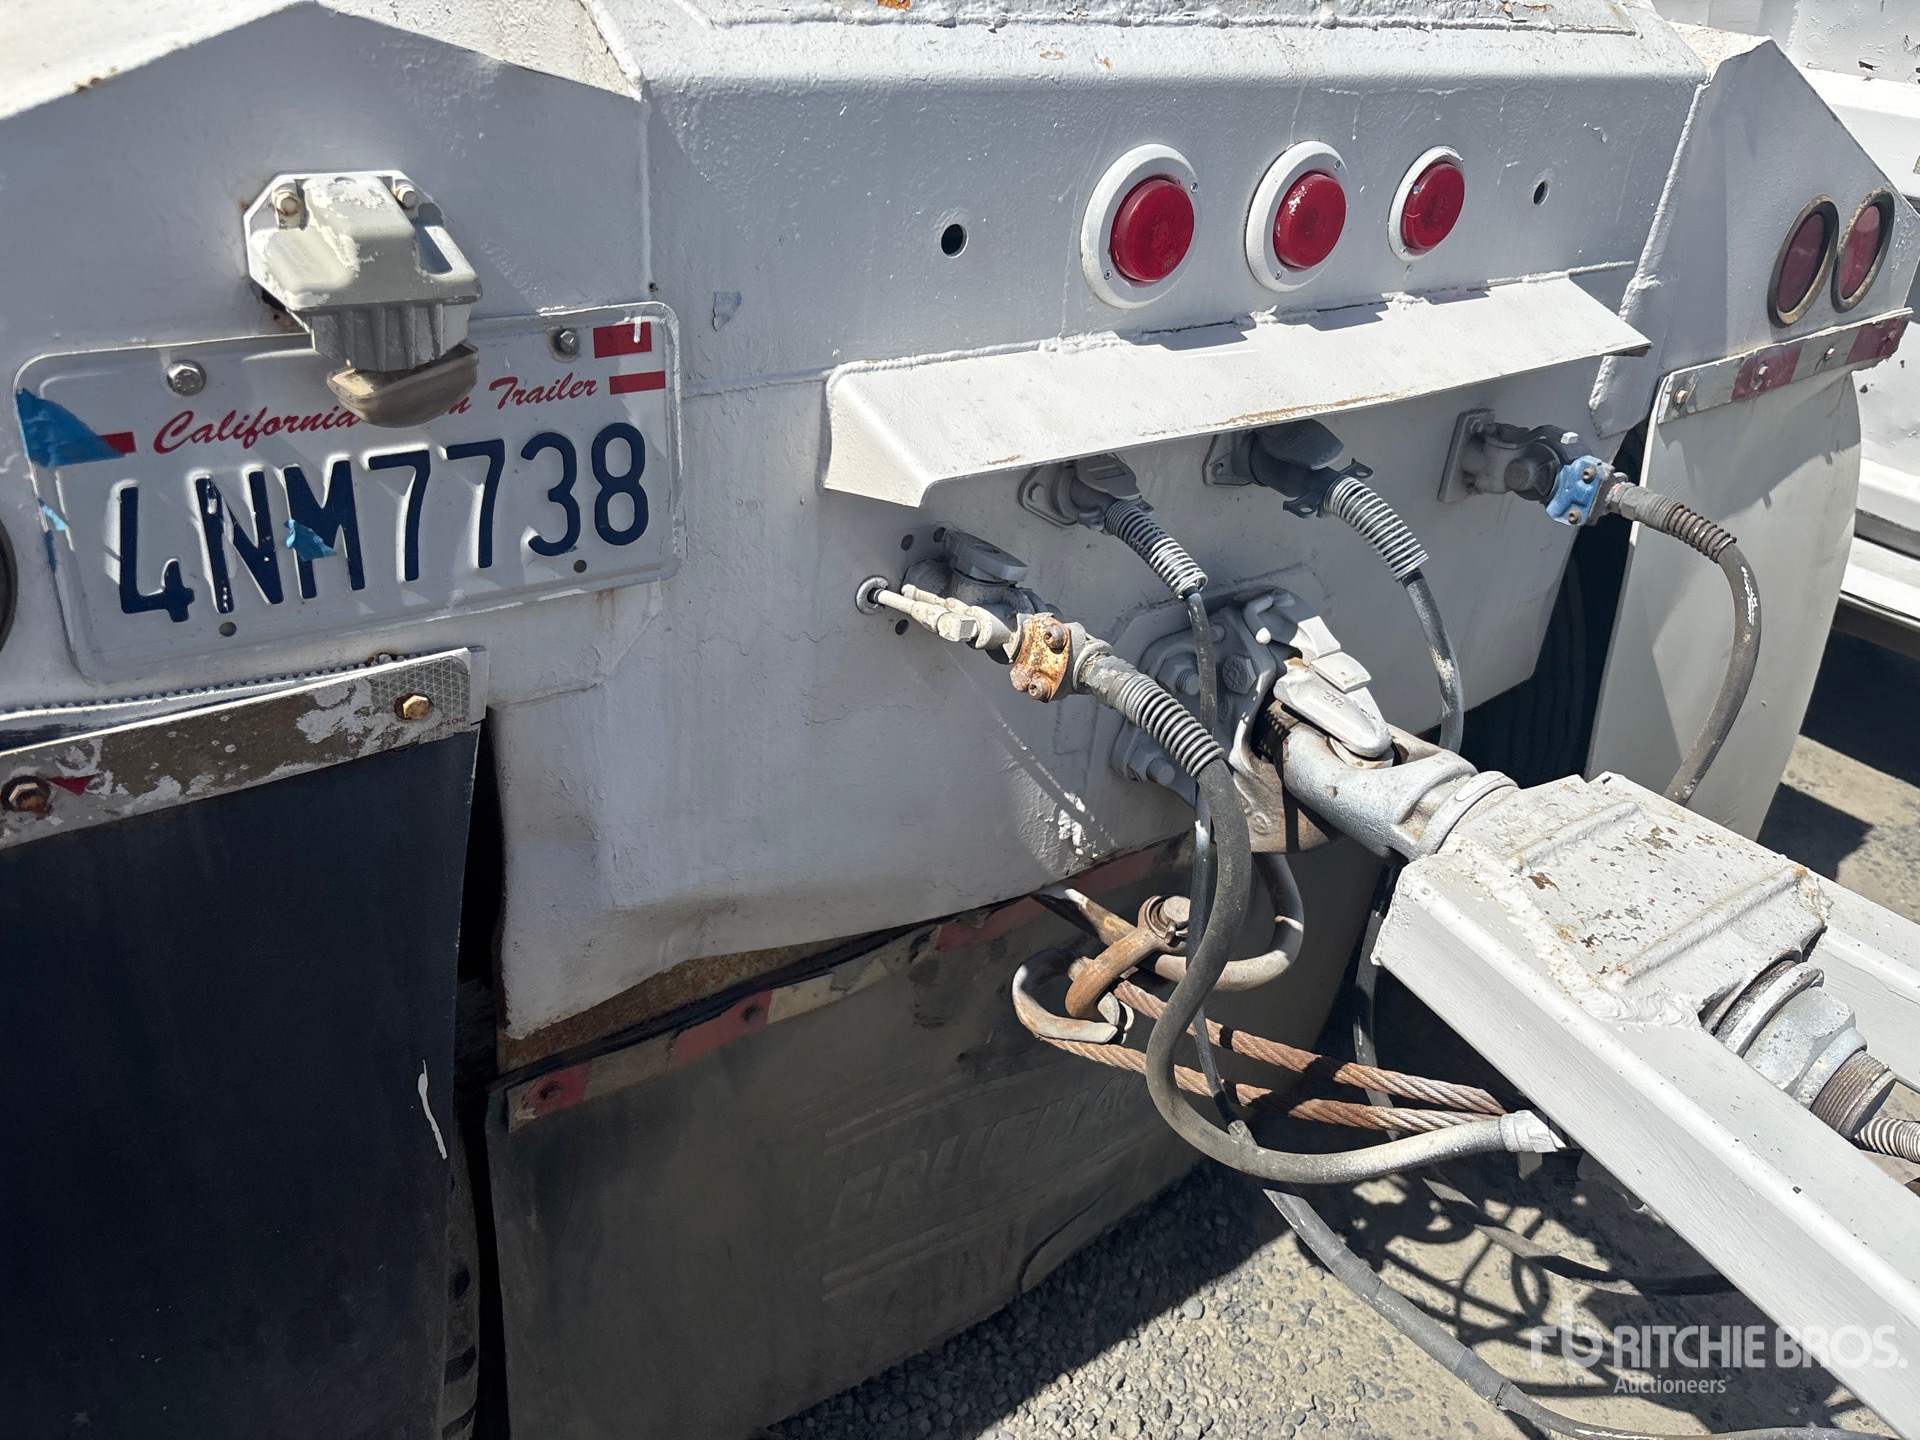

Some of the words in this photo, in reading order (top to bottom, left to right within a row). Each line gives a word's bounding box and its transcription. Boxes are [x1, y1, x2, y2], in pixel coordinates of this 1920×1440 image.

[153, 405, 358, 455] California
[488, 372, 599, 410] Trailer
[118, 422, 650, 622] 4NM7738
[1323, 691, 1345, 709] 272
